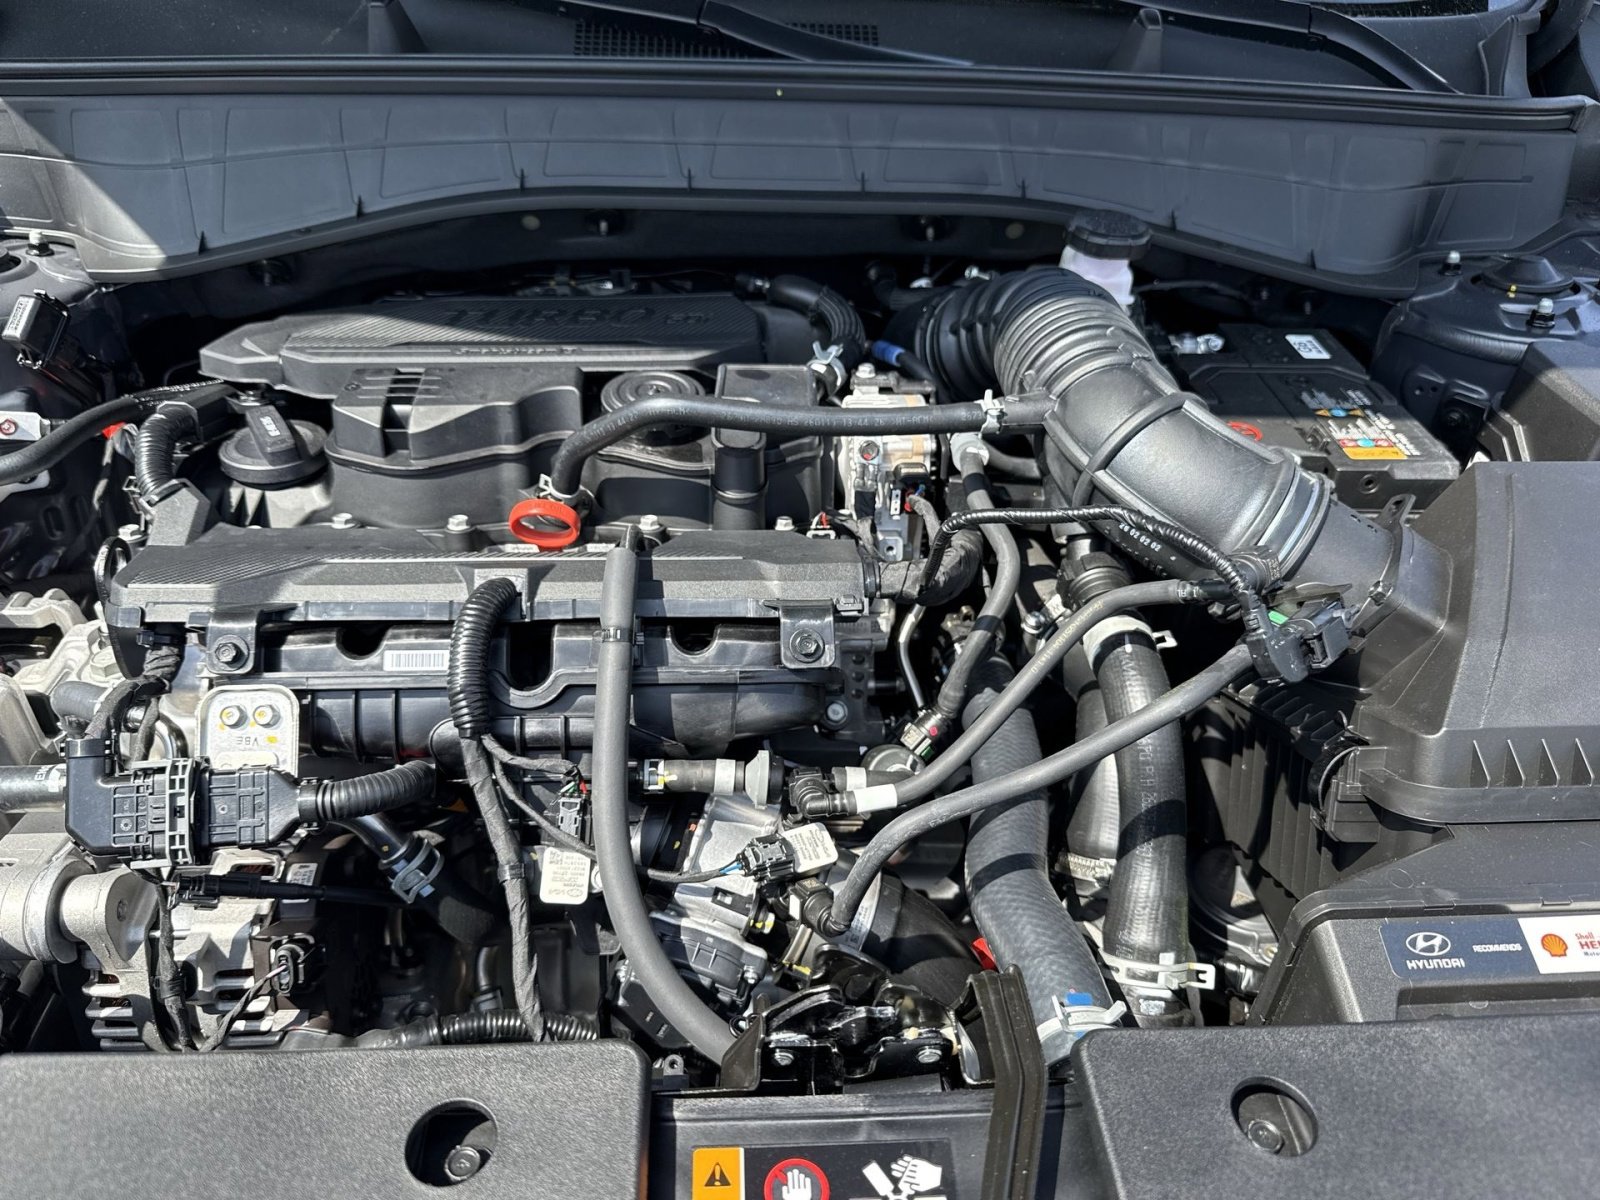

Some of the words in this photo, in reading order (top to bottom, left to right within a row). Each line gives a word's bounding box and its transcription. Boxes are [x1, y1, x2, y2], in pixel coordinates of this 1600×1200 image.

[1130, 528, 1140, 539] 02
[1140, 535, 1150, 546] 02
[1150, 541, 1161, 552] 02
[1406, 958, 1466, 970] HYUNDAI
[1472, 943, 1522, 953] RECOMMENDS
